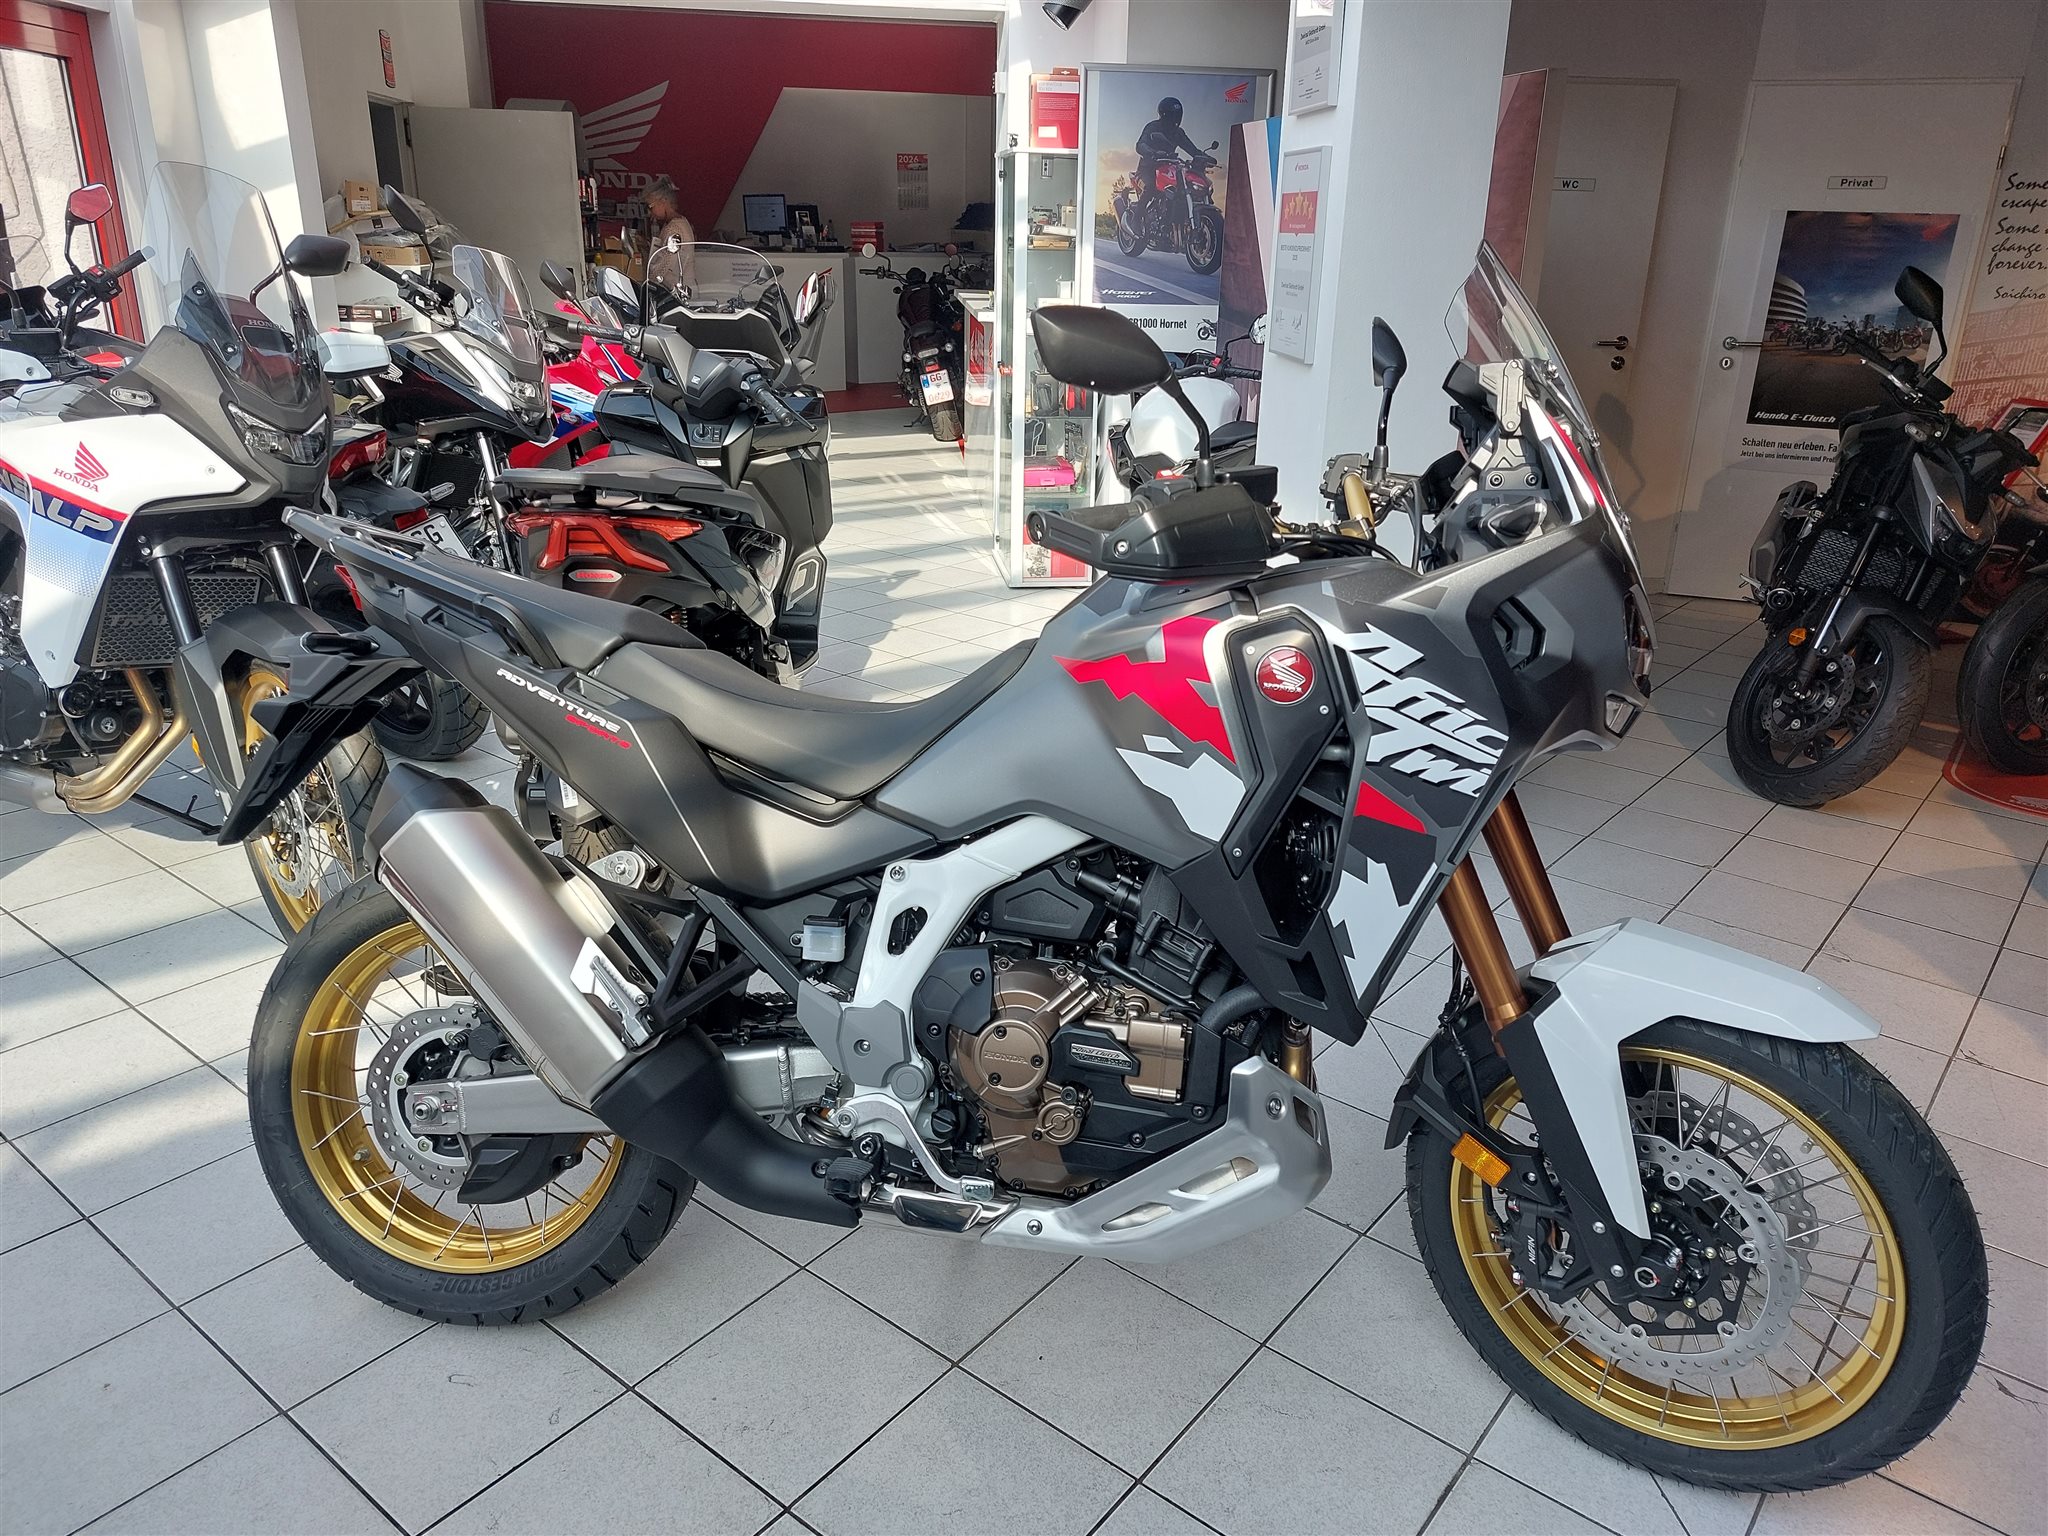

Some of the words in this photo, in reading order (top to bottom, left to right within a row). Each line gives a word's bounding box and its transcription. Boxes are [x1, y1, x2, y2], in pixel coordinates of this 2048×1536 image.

[898, 155, 920, 163] 2026
[1562, 180, 1579, 189] WC
[1840, 178, 1874, 188] Privat
[2005, 172, 2048, 191] Some
[2001, 199, 2048, 215] escape
[1995, 216, 2041, 235] Some
[1991, 237, 2042, 259] change
[1986, 252, 2047, 275] forever.
[1993, 286, 2047, 300] Soichiro
[1159, 318, 1188, 329] Hornet
[929, 371, 942, 383] GG
[1754, 411, 1789, 420] Honda
[1790, 413, 1837, 423] E-Clutch
[1741, 437, 1776, 448] Schalten
[1777, 441, 1793, 449] neu
[1793, 441, 1826, 452] erleben.
[1827, 443, 1840, 453] Fa
[1755, 450, 1764, 458] bei
[1775, 452, 1809, 461] informieren
[53, 467, 100, 493] HONDA
[1263, 682, 1304, 694] HONDA
[496, 667, 621, 733] ADVENTURE
[565, 713, 632, 750] SPORTS
[984, 1051, 1028, 1065] HONDA
[431, 1252, 560, 1295] BRIDGESTONE
